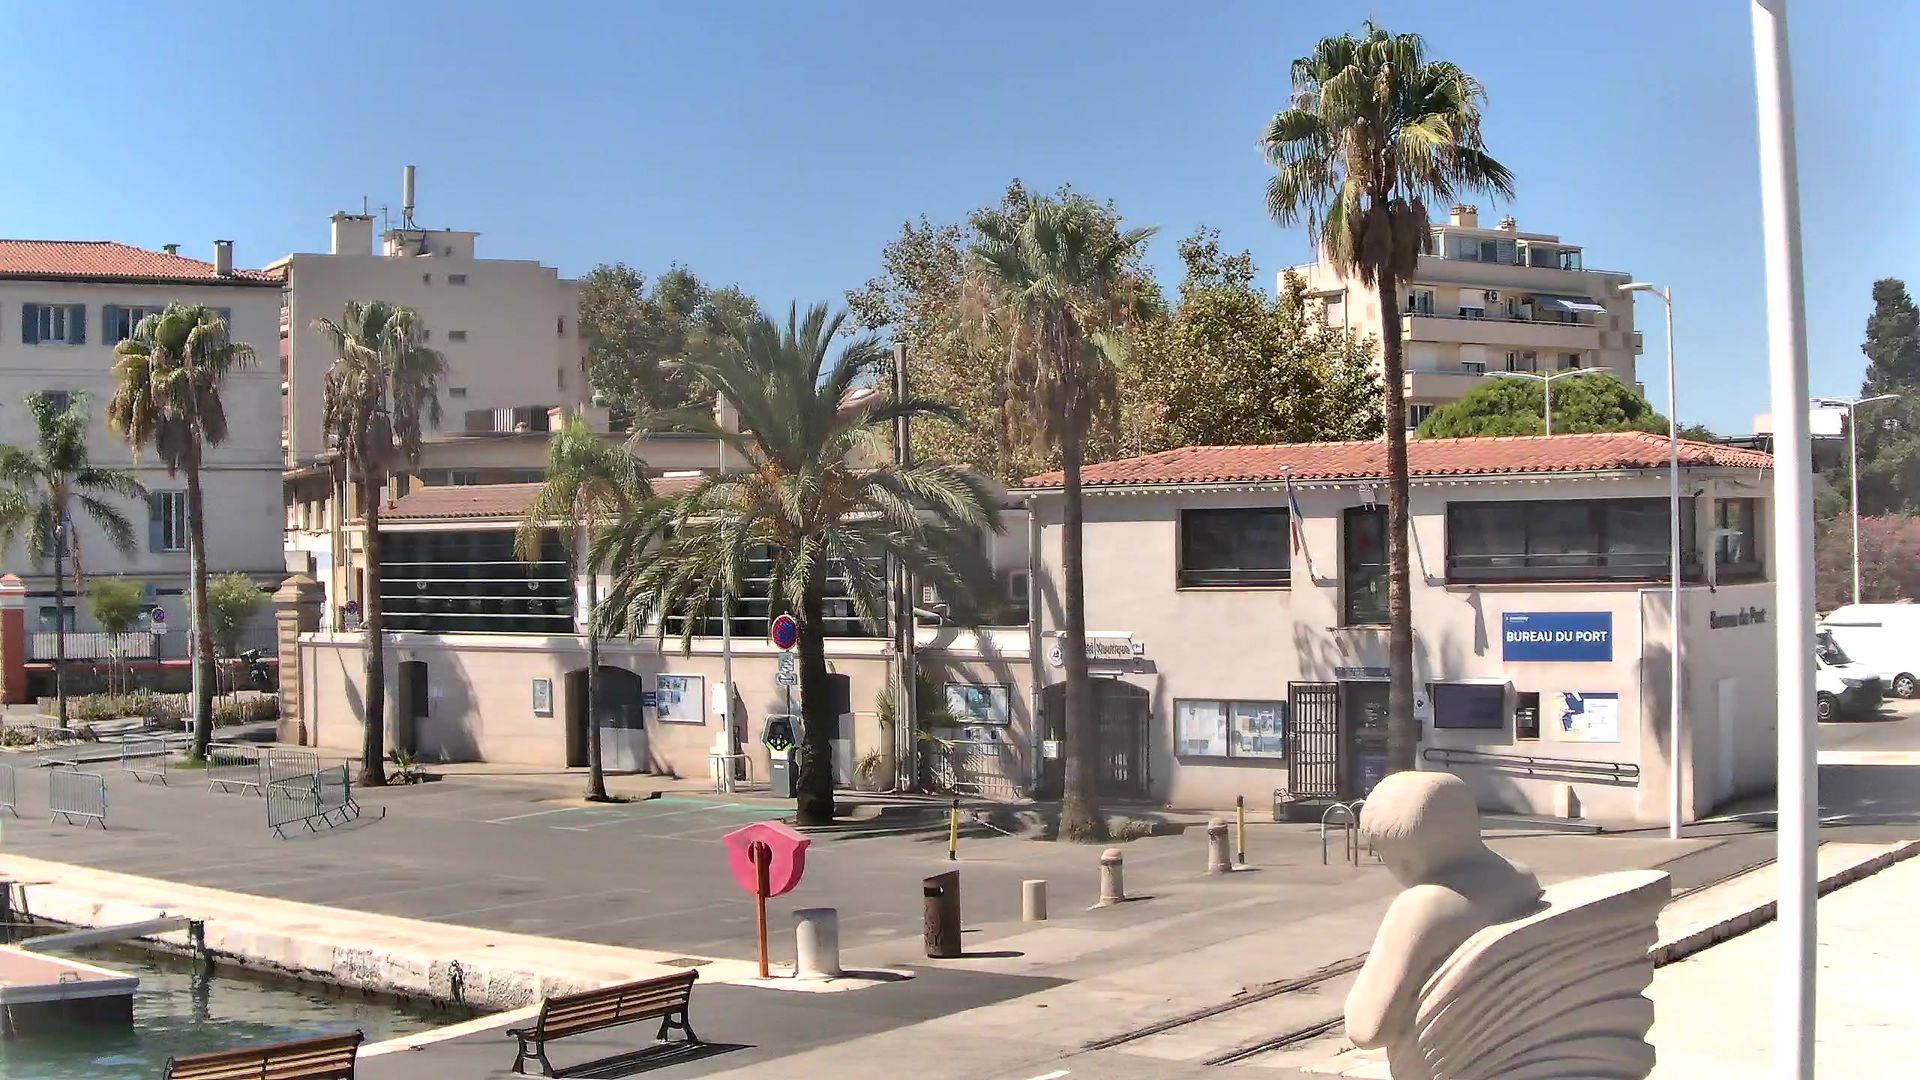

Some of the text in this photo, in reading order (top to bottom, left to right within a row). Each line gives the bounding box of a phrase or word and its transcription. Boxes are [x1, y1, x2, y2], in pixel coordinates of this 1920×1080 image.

[1506, 631, 1608, 642] BUREAU DU PORT
